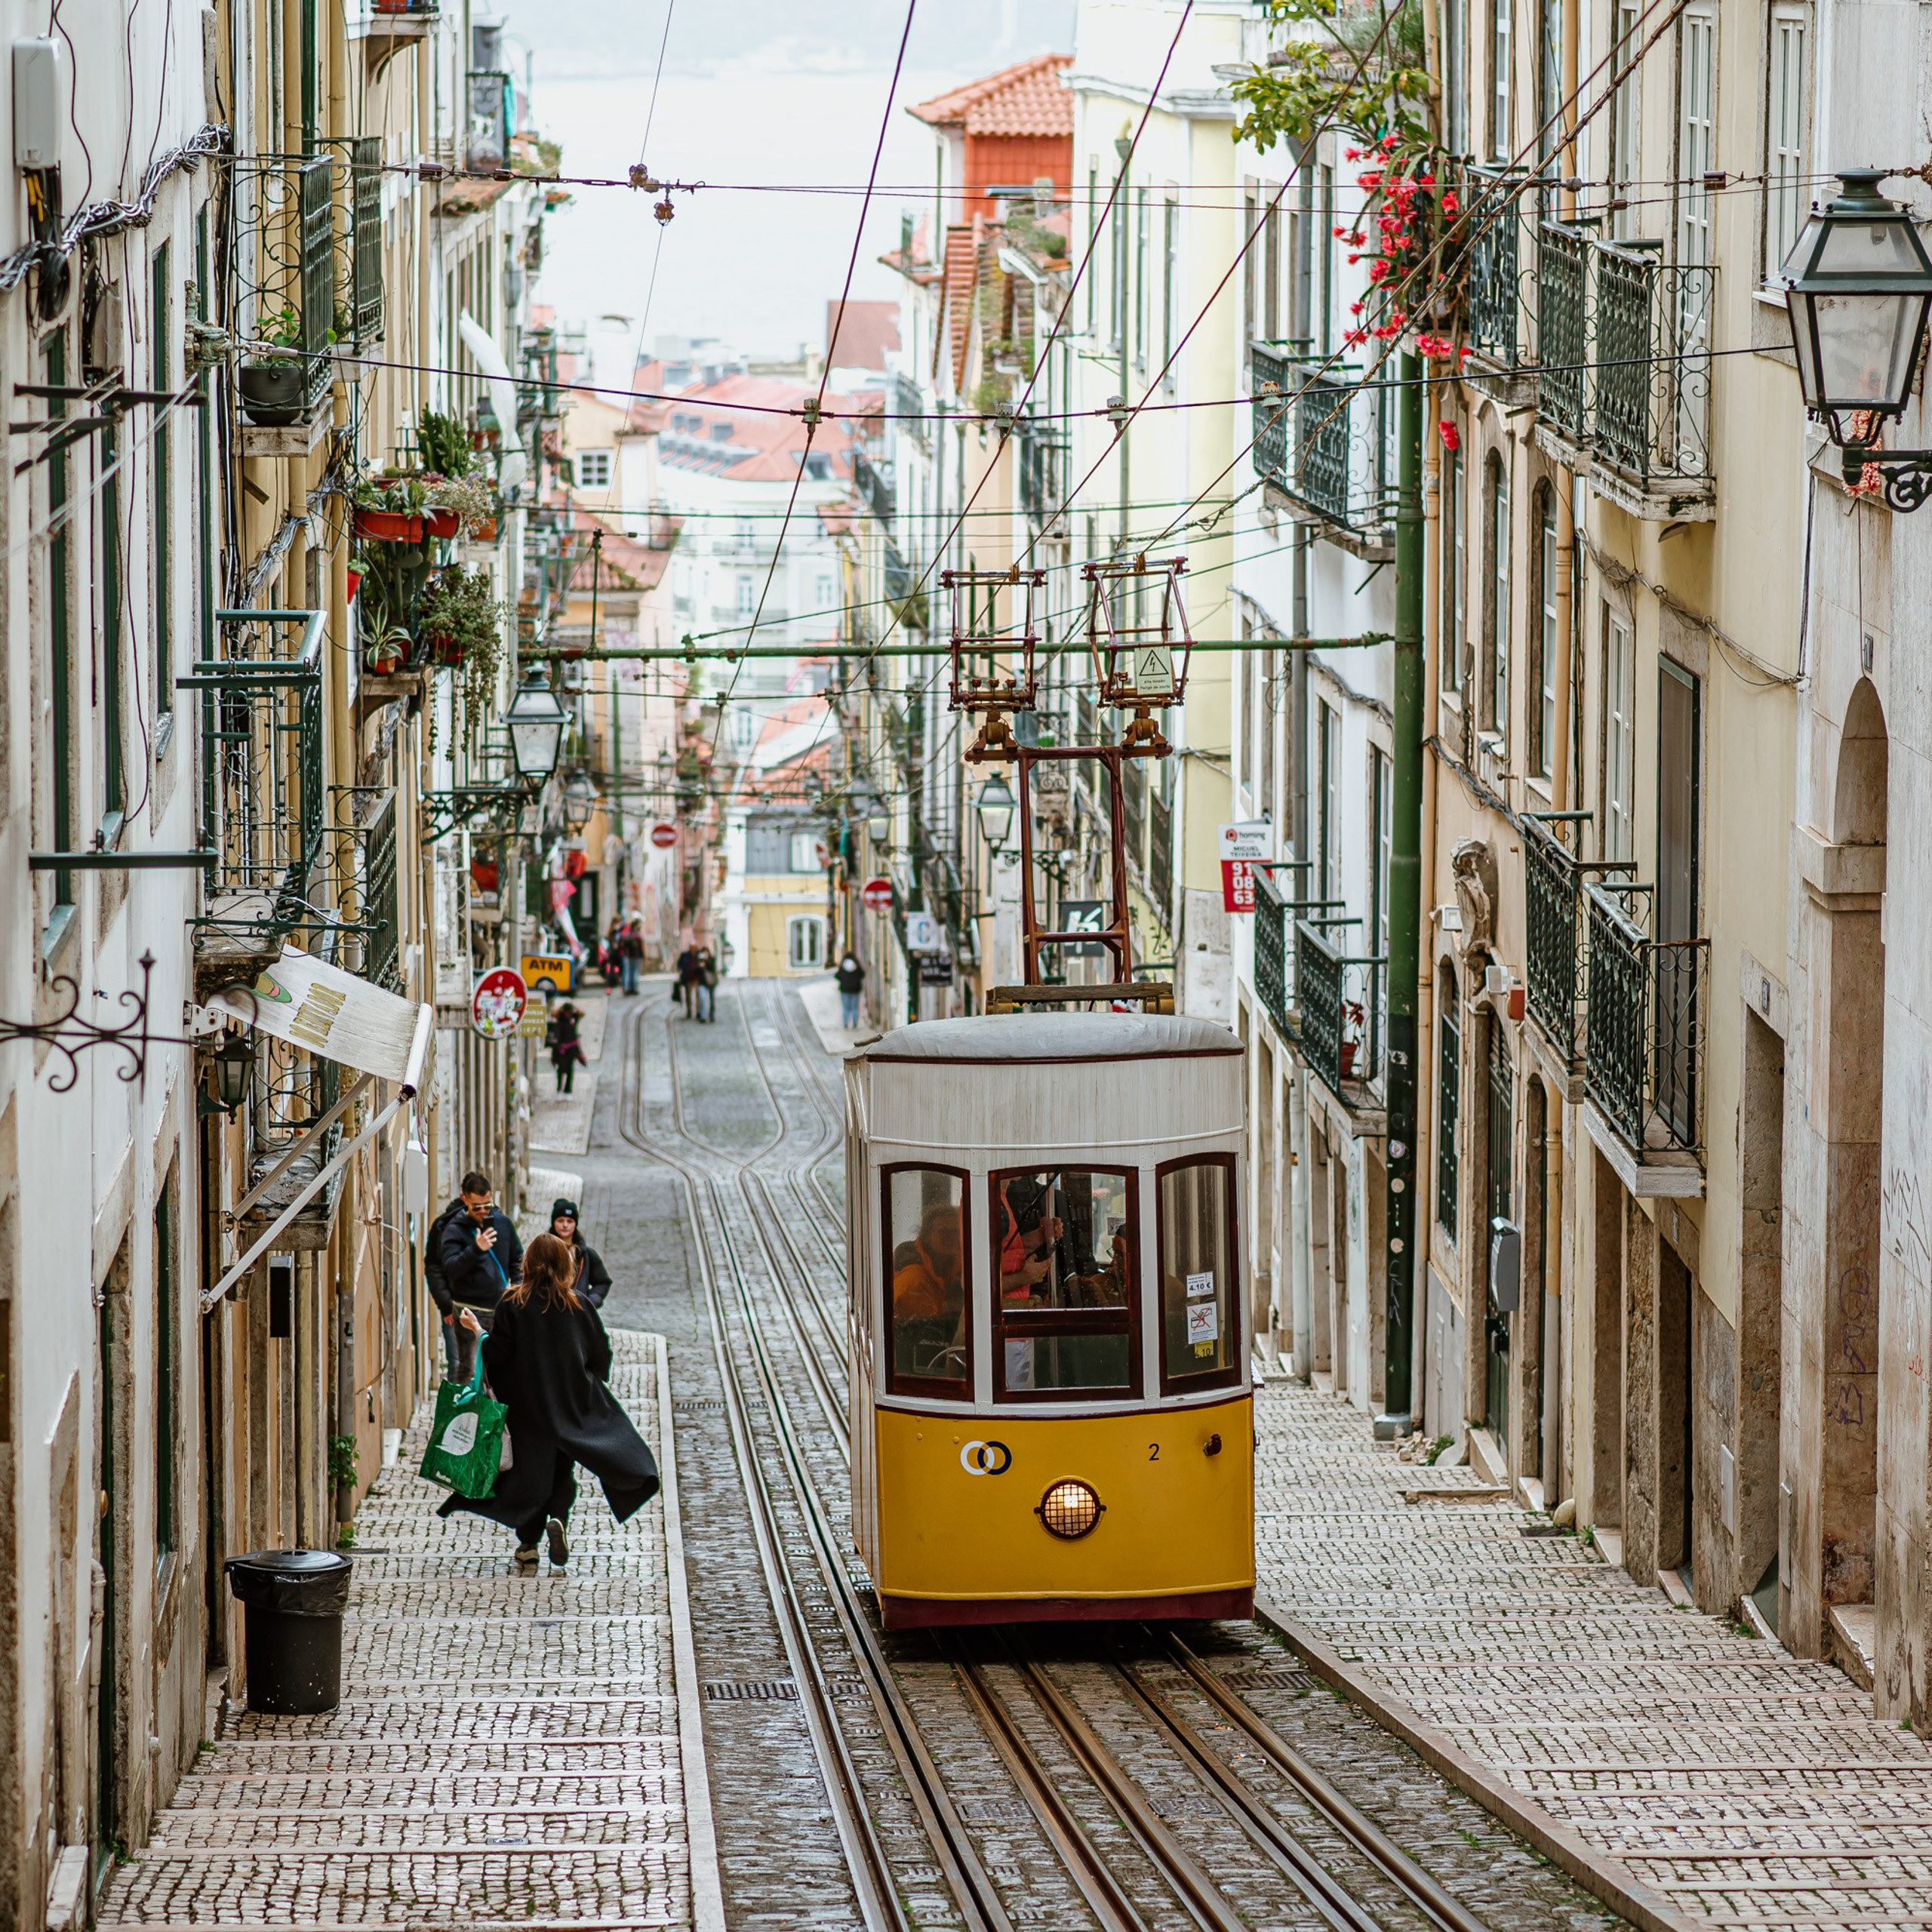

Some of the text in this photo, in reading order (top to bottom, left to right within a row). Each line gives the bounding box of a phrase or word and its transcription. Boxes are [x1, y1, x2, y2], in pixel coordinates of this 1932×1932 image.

[1239, 831, 1266, 841] homing
[529, 959, 563, 971] ATM
[1189, 1283, 1204, 1291] 4.10
[1148, 1443, 1160, 1461] 2
